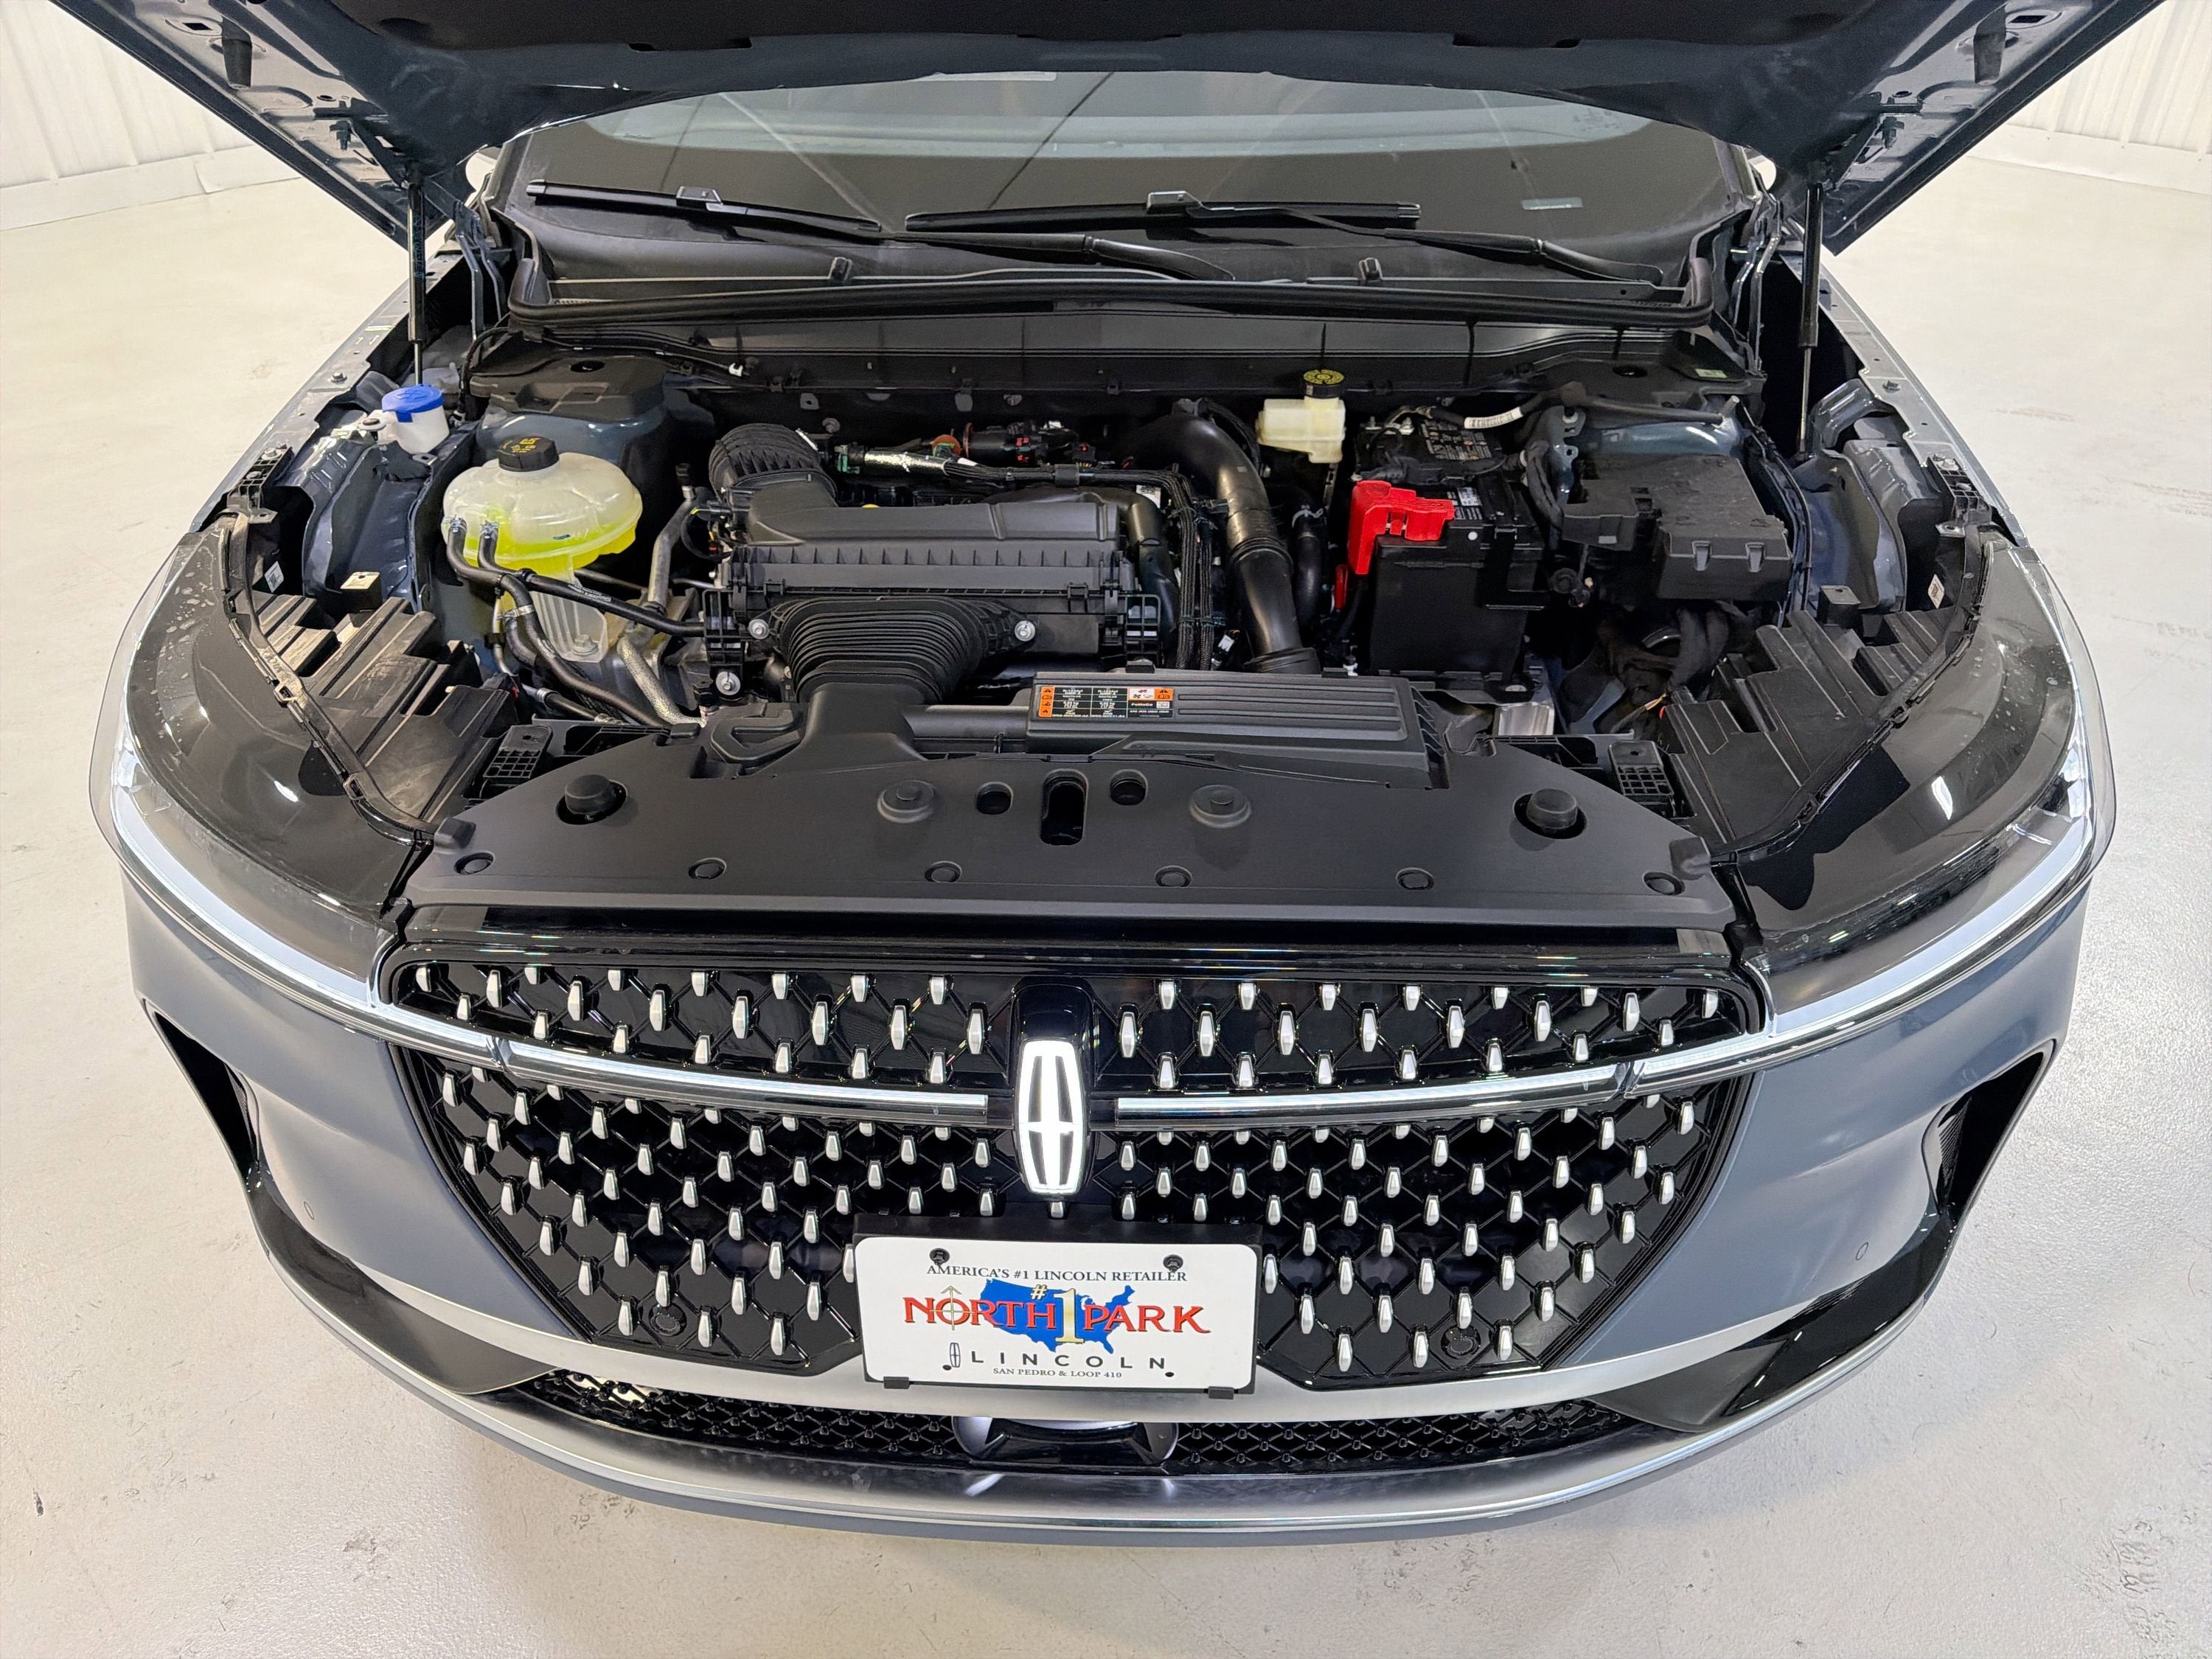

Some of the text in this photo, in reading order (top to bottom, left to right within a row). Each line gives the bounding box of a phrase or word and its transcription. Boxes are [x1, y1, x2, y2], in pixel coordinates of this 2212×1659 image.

[926, 1265, 1188, 1281] AMERICA'S #1 LINCOLN RETAILER
[902, 1296, 1211, 1334] NORTH PARK
[971, 1351, 1165, 1369] LINCOLN
[1018, 1368, 1056, 1377] PEDRO
